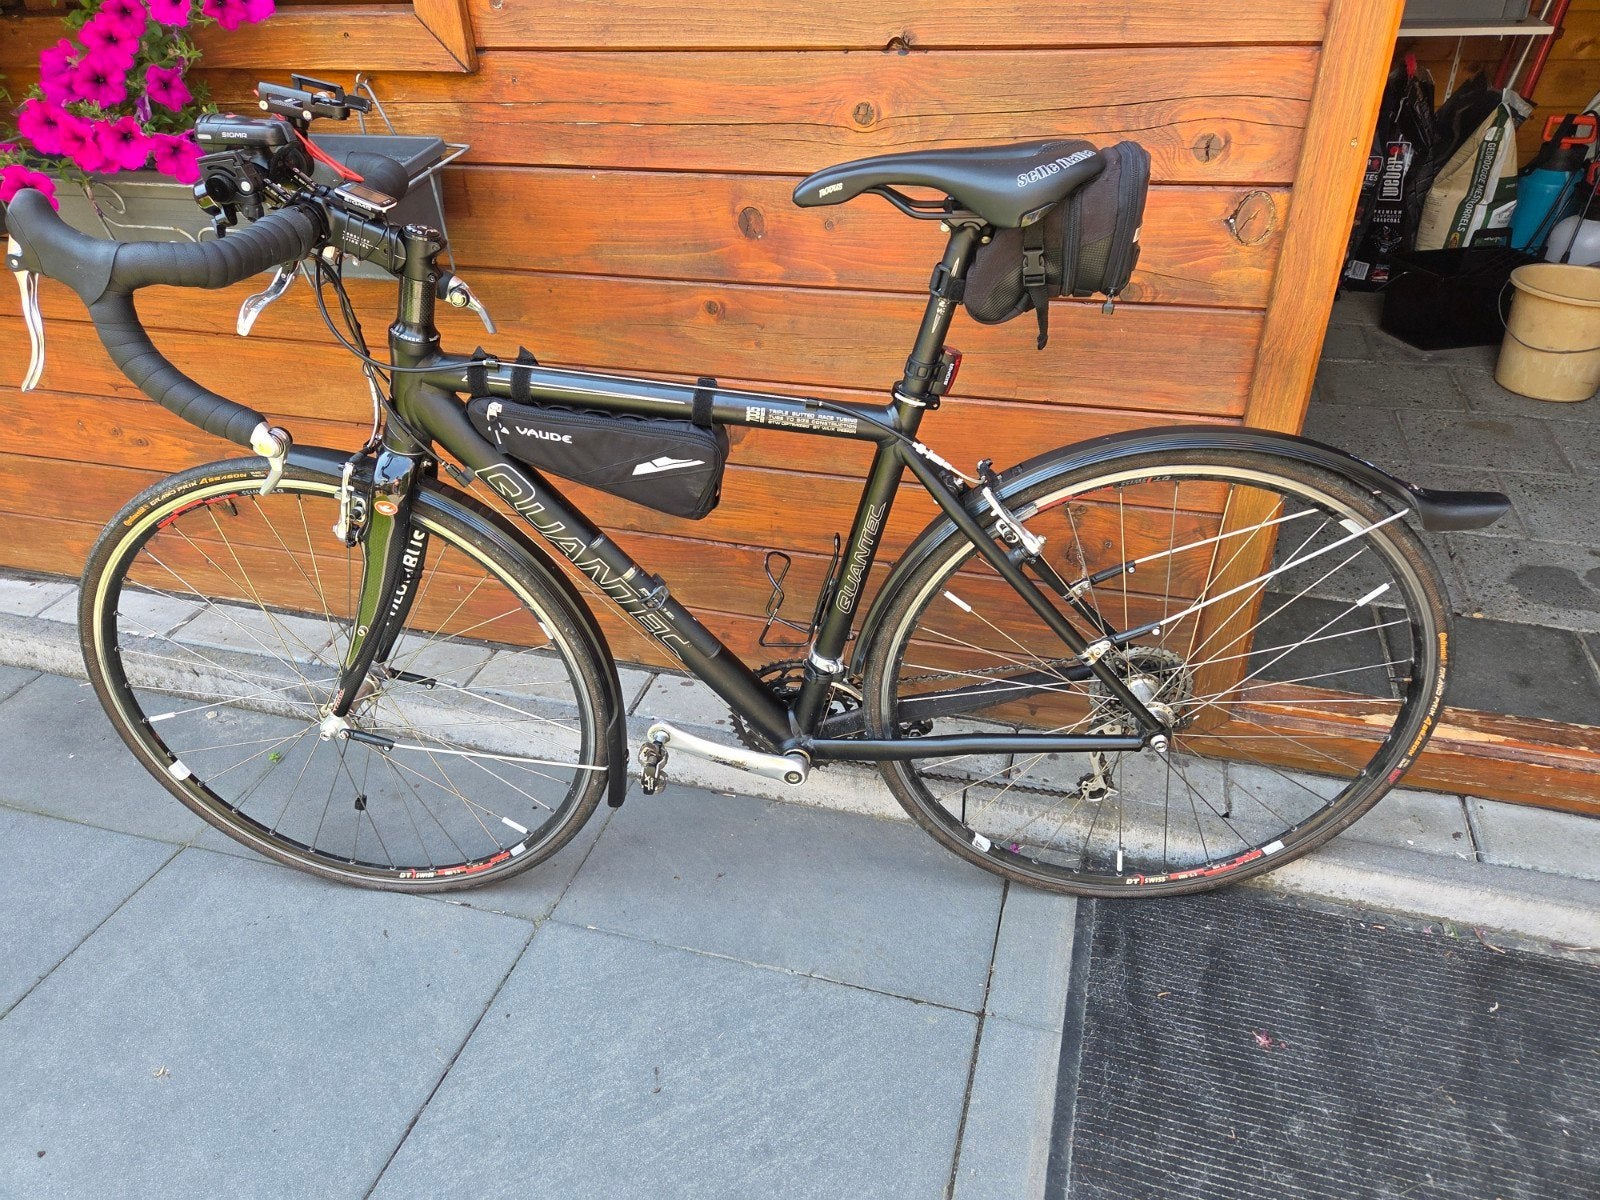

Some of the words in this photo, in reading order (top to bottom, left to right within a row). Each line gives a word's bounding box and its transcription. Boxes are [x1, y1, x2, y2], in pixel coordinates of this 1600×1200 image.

[221, 131, 247, 139] SIGMA
[1016, 162, 1060, 188] selle
[1382, 151, 1404, 197] weber
[515, 425, 573, 444] VAUDE
[474, 463, 690, 661] QUANTEC
[835, 501, 887, 615] QUANTEC
[1125, 877, 1140, 885] DT
[1144, 875, 1167, 885] SWISS
